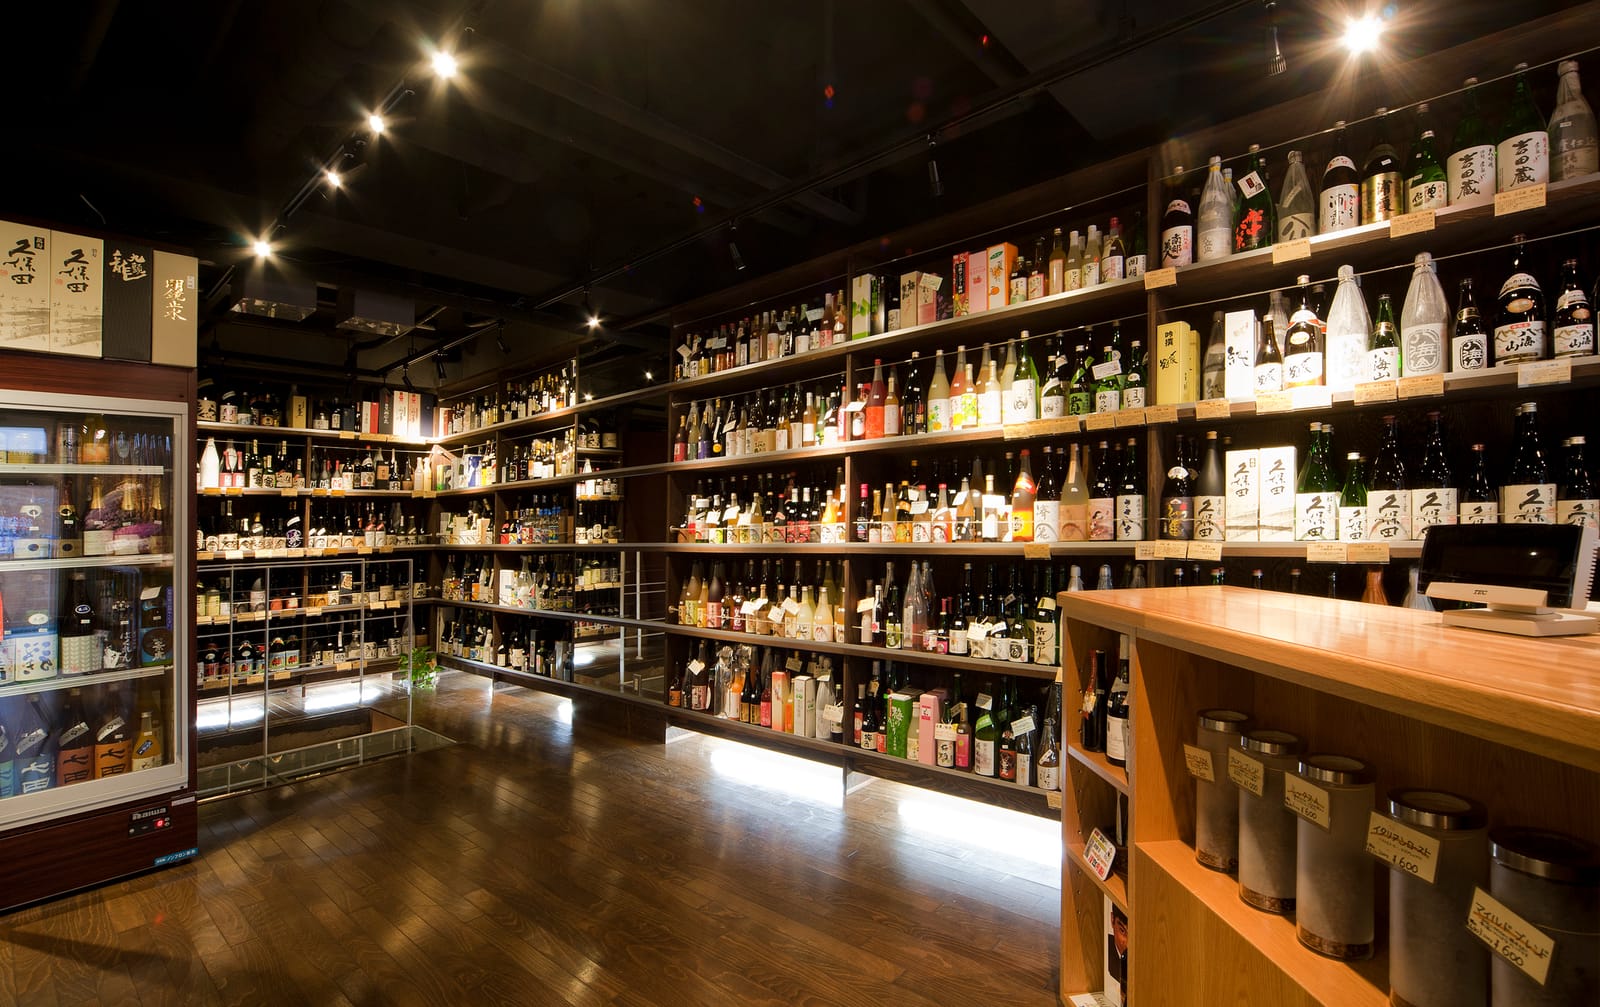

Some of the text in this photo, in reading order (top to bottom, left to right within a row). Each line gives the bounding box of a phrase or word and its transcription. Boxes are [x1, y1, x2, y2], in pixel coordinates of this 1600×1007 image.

[1457, 151, 1480, 200] 吉田蔵
[1510, 138, 1539, 187] 吉田蔵
[3, 238, 36, 285] 久保田
[59, 248, 90, 293] 久保田
[1230, 462, 1250, 498] 久保田
[1264, 459, 1287, 496] 久保田
[1197, 499, 1215, 538] 久保田
[1302, 495, 1326, 537] 久保田
[1345, 509, 1364, 540] 久保田
[1374, 494, 1402, 538] 久保田
[1513, 488, 1545, 524] 久保
[1474, 900, 1550, 960] マイルドブレンド
